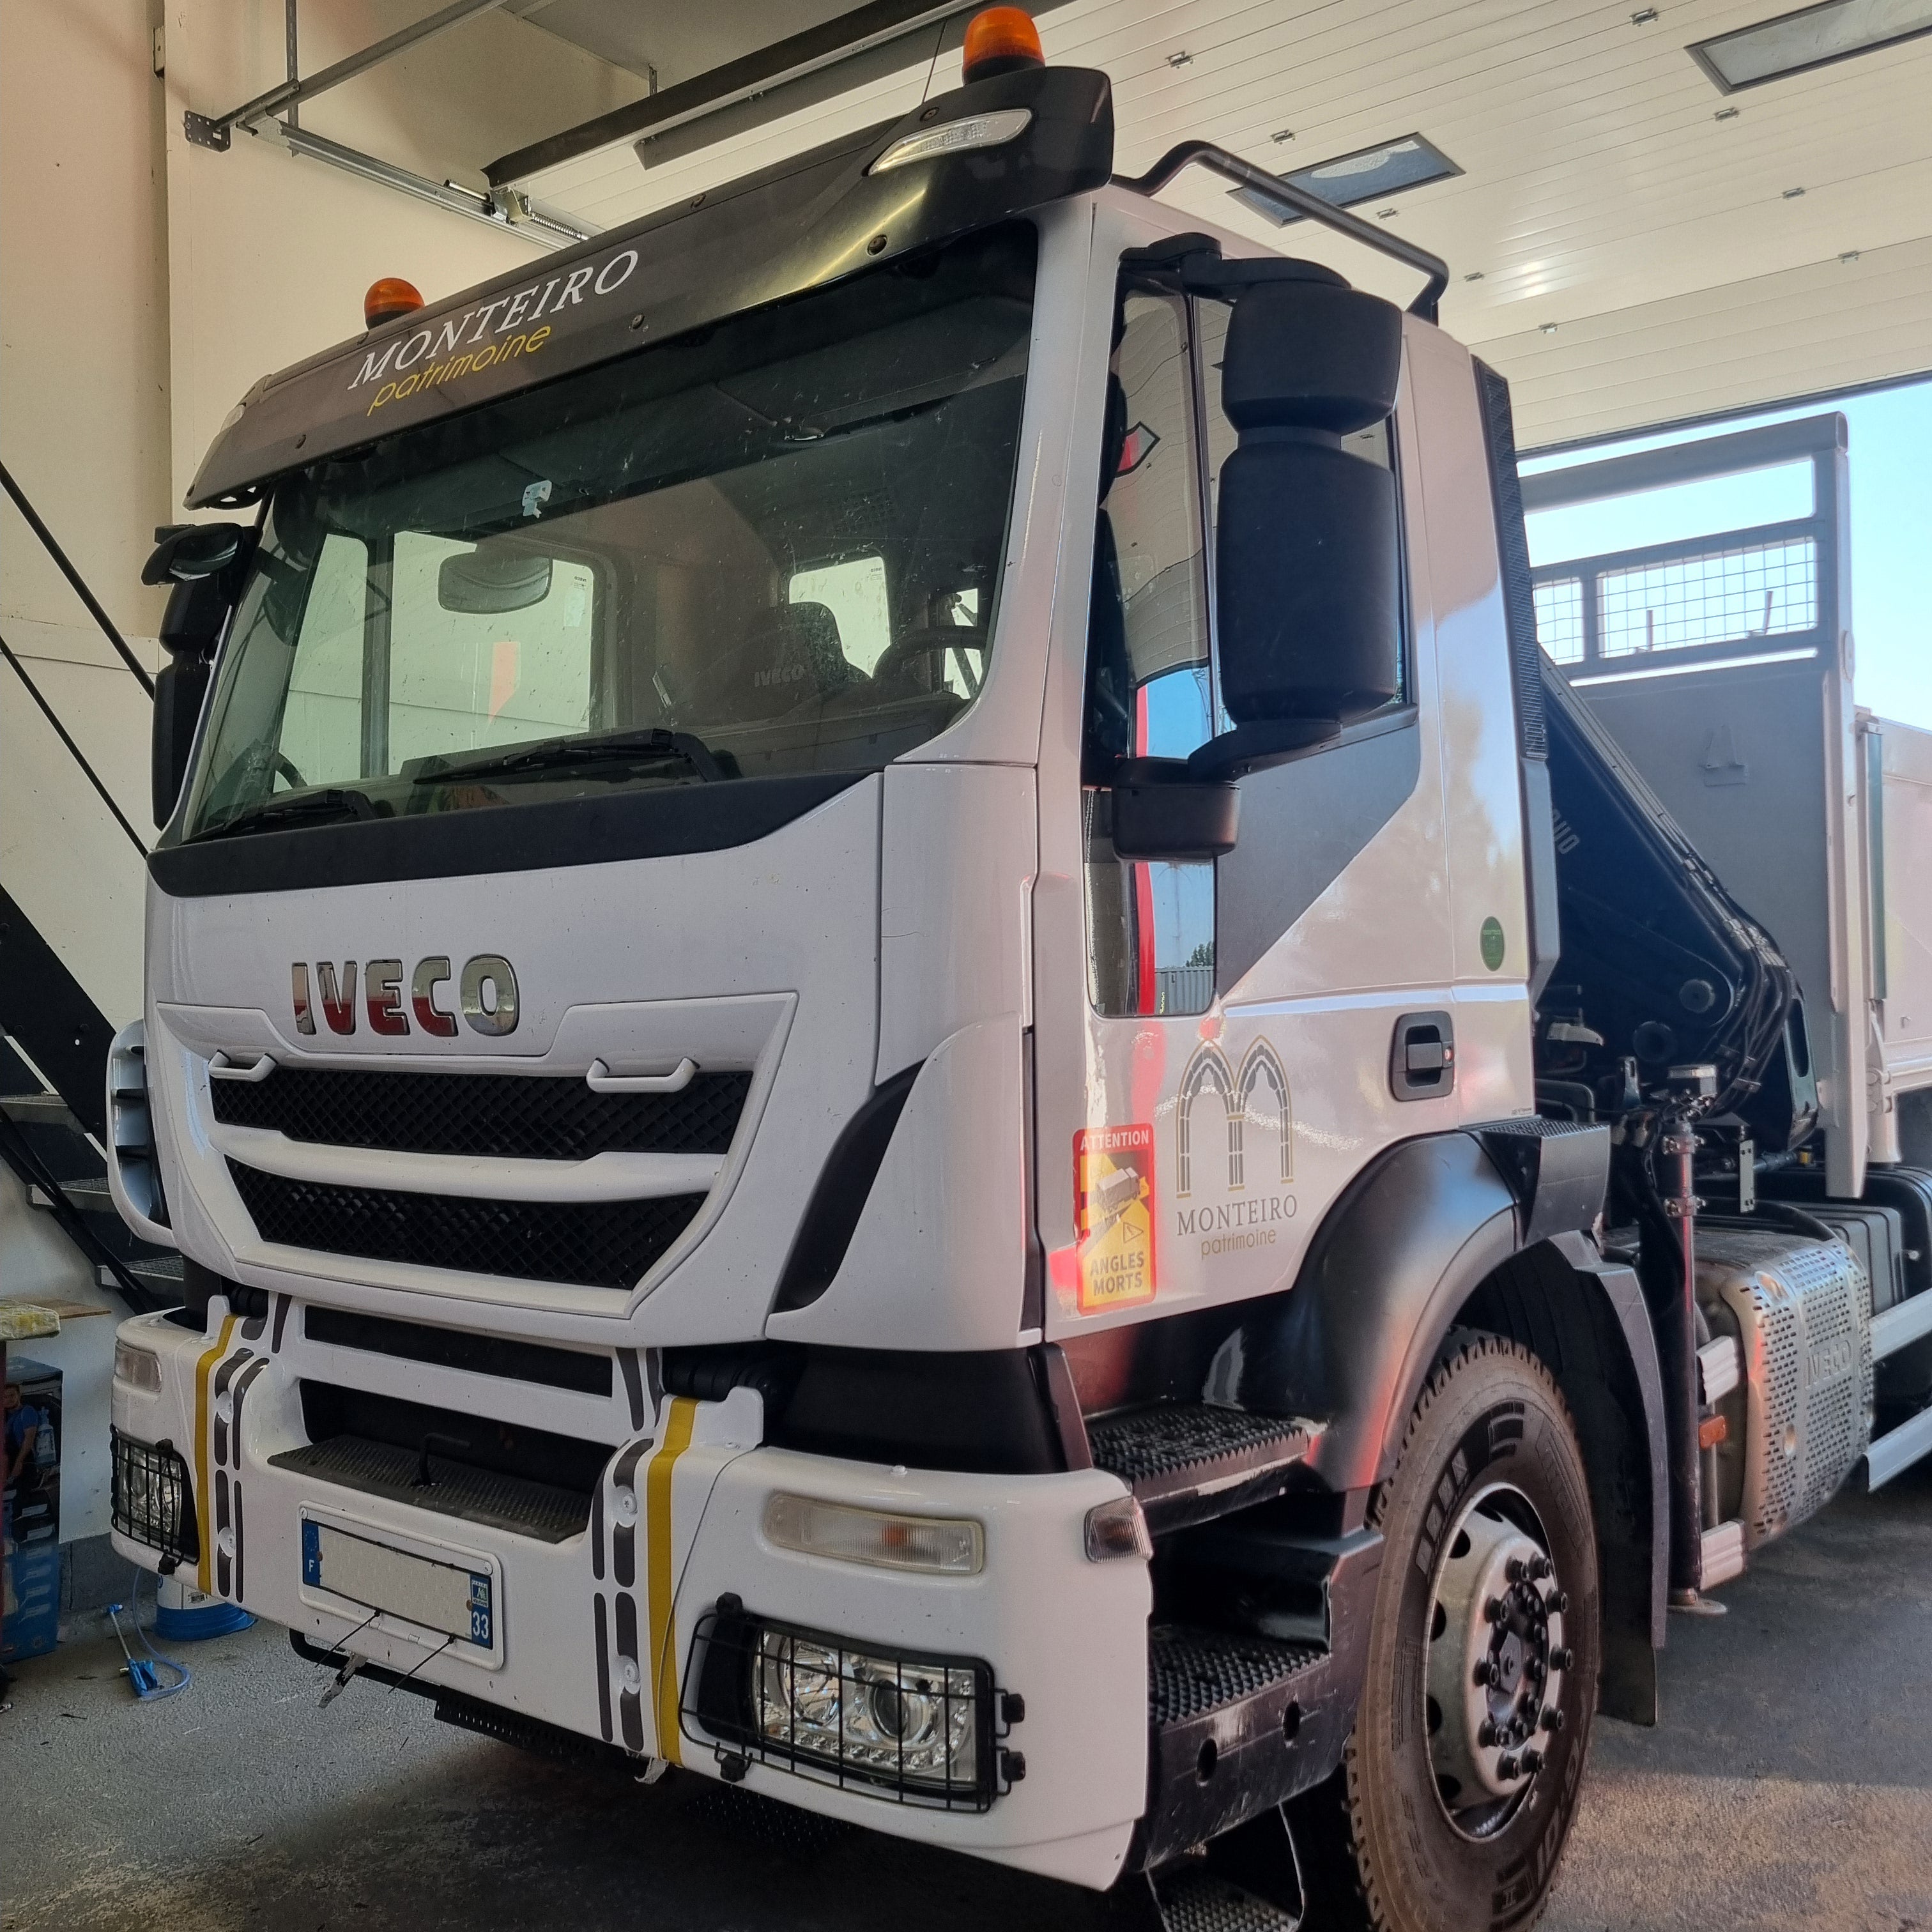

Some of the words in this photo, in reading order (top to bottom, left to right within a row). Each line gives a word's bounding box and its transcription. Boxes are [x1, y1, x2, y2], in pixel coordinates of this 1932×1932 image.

[348, 250, 638, 390] MONTEIRO
[367, 326, 552, 416] patrimoine
[755, 664, 804, 687] IVECO
[292, 954, 520, 1036] IVECO
[1080, 1130, 1149, 1150] ATTENTION
[1177, 1194, 1298, 1236] MONTEIRO
[1201, 1228, 1276, 1261] patrimoine
[1090, 1251, 1144, 1276] ANGLES
[1093, 1271, 1142, 1296] MORTS
[309, 1559, 315, 1572] F
[473, 1611, 489, 1639] 33
